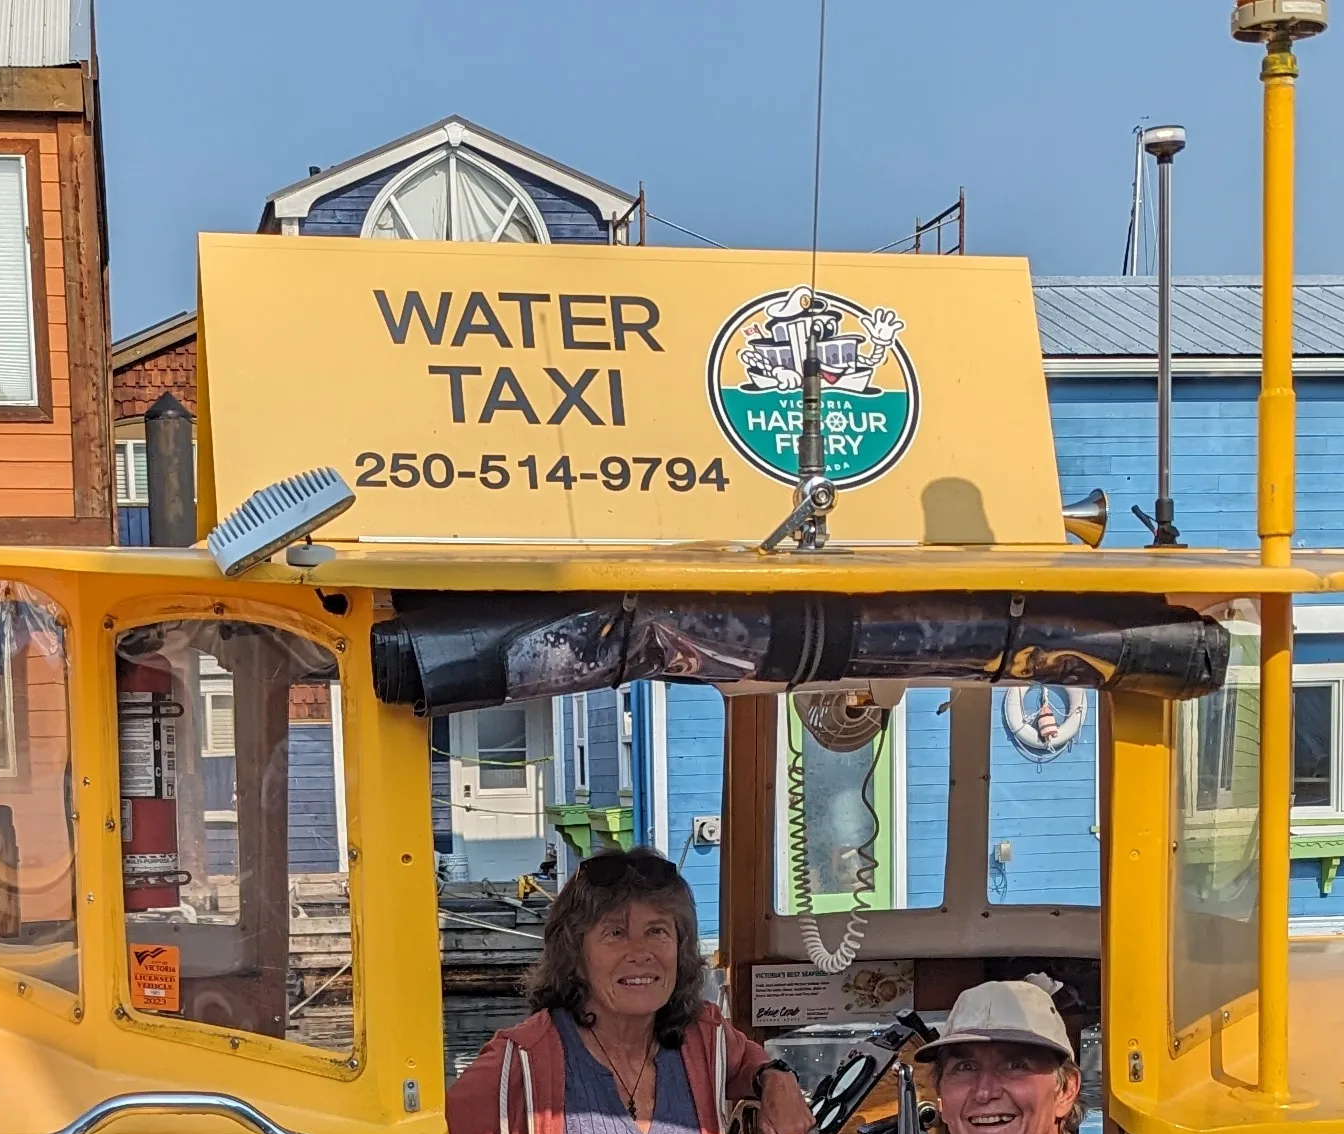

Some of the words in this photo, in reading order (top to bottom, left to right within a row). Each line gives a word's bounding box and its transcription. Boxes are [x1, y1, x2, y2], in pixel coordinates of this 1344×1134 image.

[372, 289, 666, 353] WATER
[427, 364, 627, 427] TAXI
[778, 399, 853, 410] VICRIA
[746, 410, 888, 433] HAROUR
[775, 433, 864, 456] FRY
[355, 451, 731, 493] 250-514-9794
[144, 964, 177, 973] VICTORIA
[143, 997, 167, 1006] 2023
